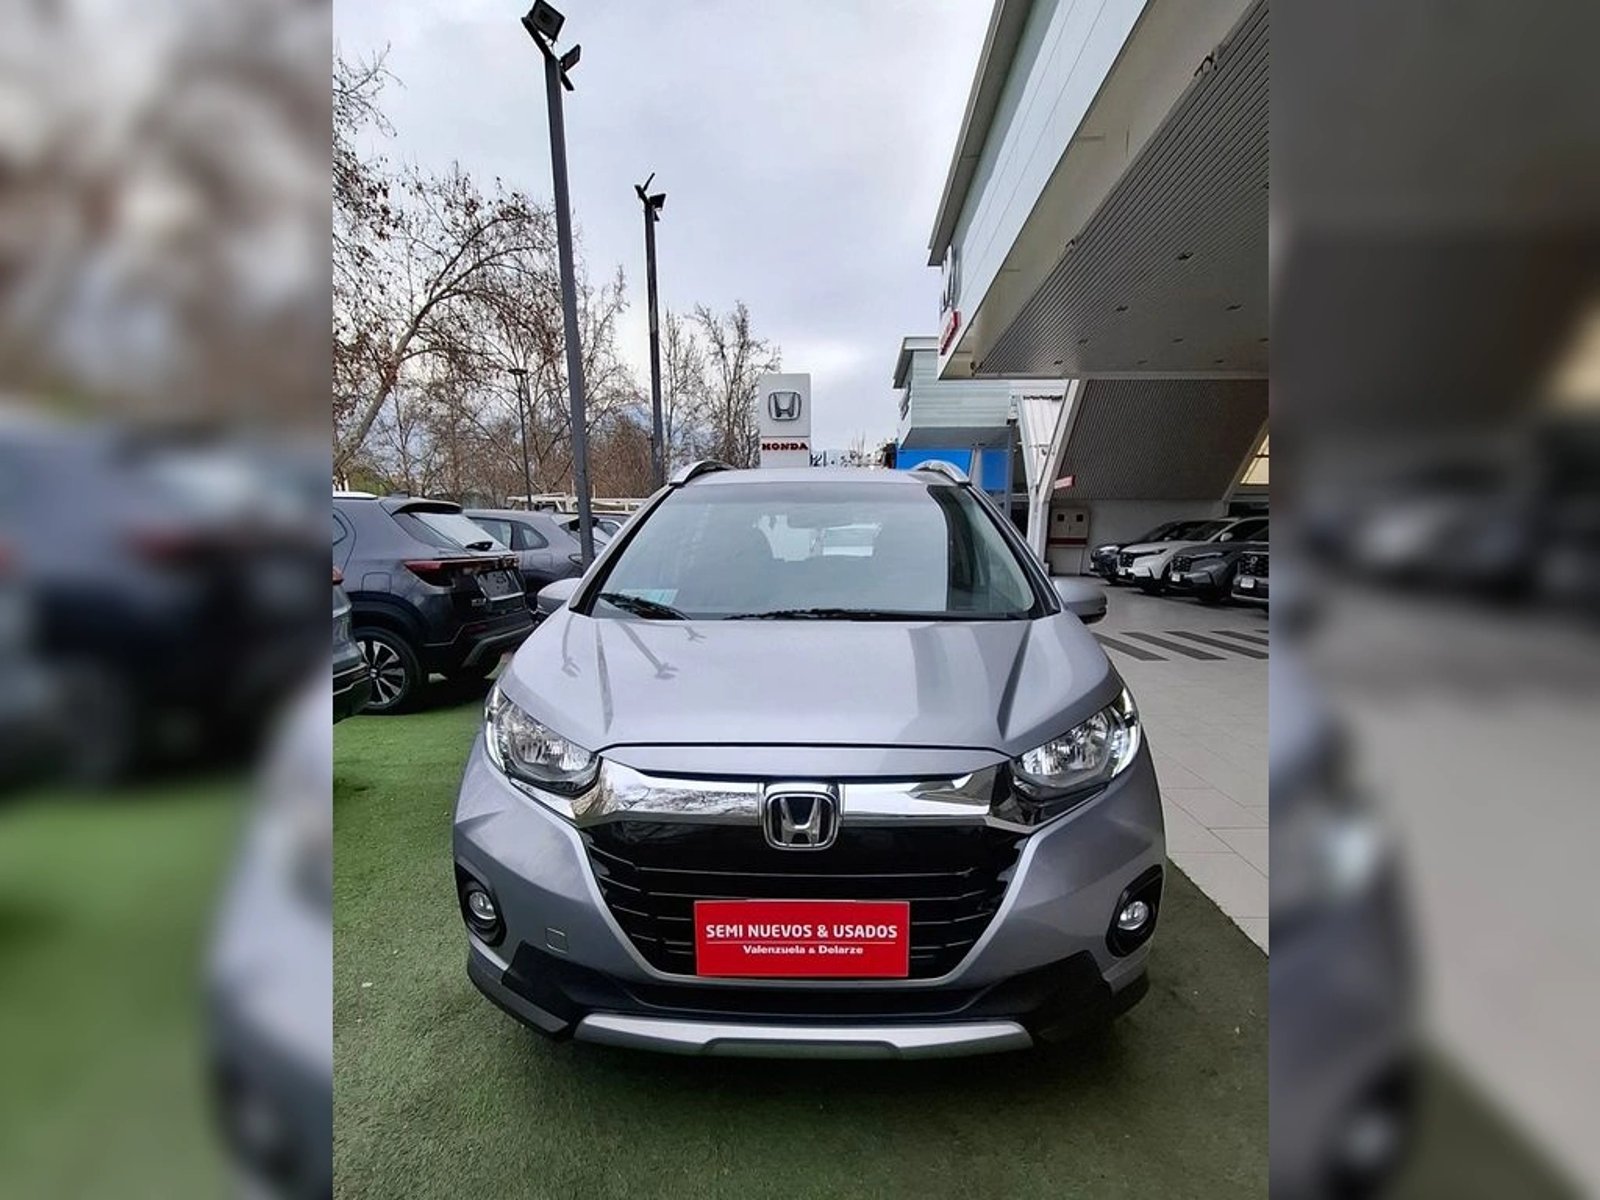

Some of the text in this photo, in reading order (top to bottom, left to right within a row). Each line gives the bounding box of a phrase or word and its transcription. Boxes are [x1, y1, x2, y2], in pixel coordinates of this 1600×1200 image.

[762, 443, 809, 451] HONDA
[705, 924, 898, 939] SEMI NUEVOS & USADOS
[743, 945, 805, 955] Valenzuela
[818, 945, 864, 955] Delarze
